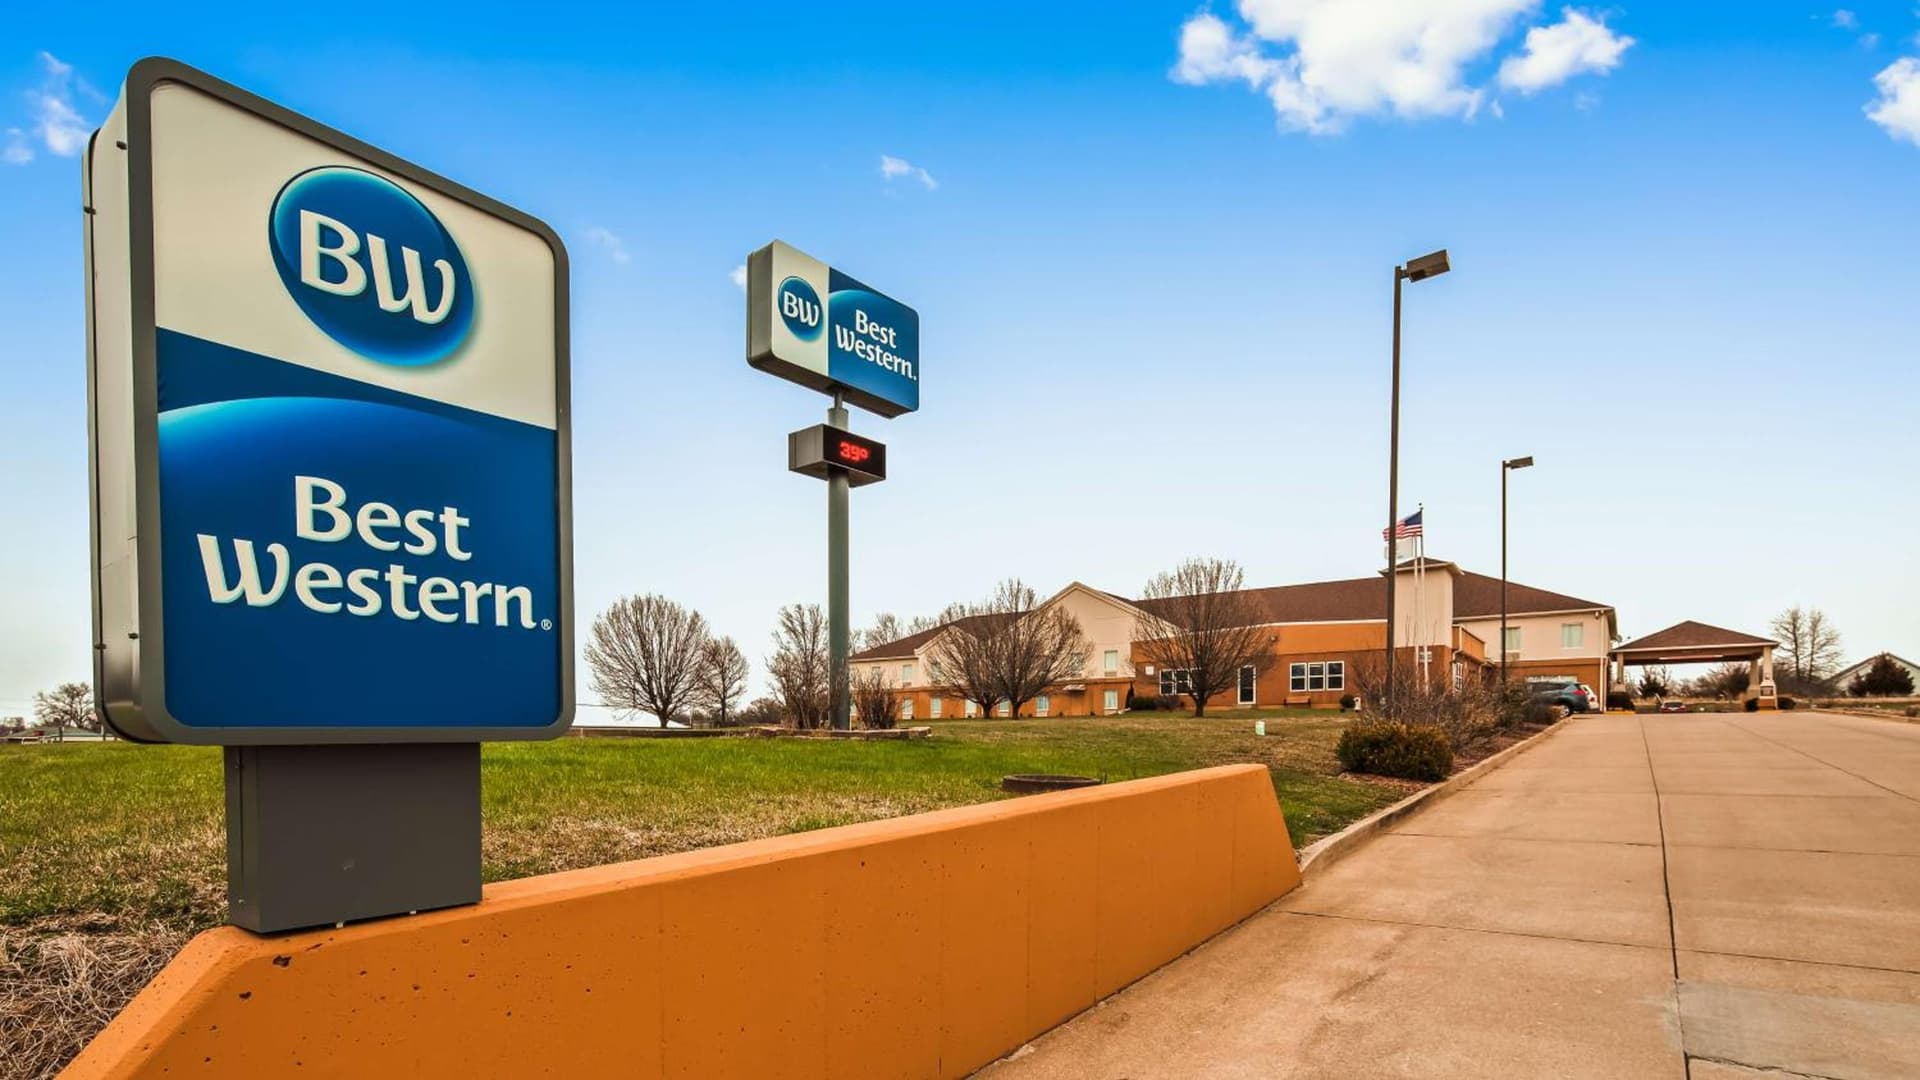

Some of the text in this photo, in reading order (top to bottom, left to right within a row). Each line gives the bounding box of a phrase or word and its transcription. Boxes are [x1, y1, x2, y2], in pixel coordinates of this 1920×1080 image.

[299, 209, 455, 324] BW
[783, 291, 819, 327] BW
[855, 310, 897, 348] Best
[294, 475, 473, 561] Best
